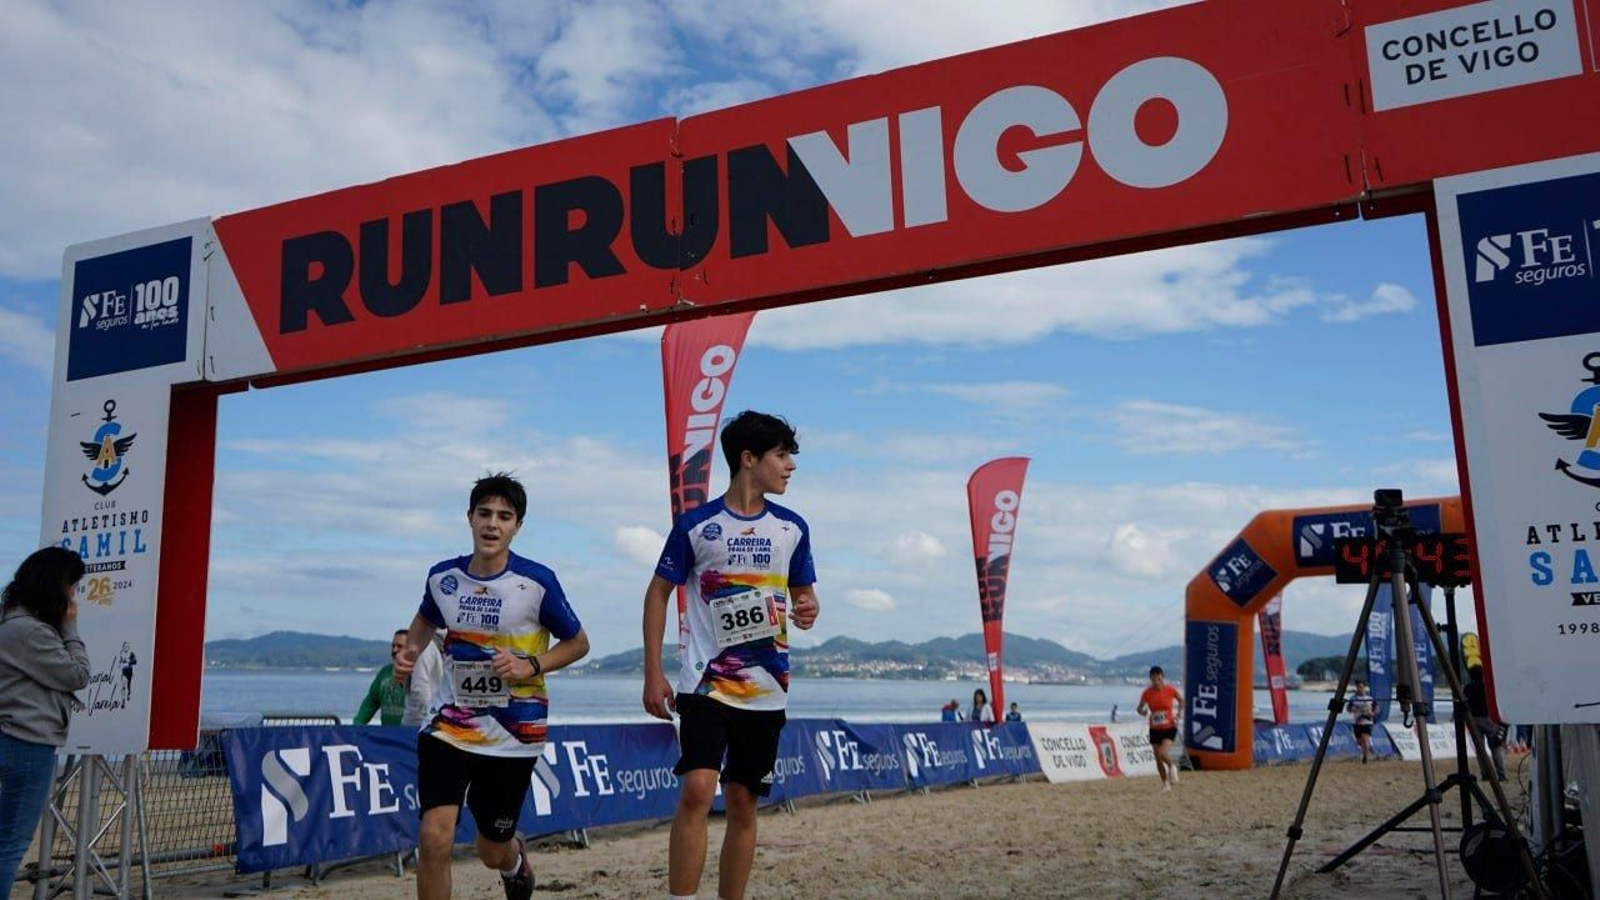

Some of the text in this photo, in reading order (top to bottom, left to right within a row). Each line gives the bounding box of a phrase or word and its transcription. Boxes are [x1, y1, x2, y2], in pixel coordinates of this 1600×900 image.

[1382, 9, 1557, 61] CONCELLO
[1405, 40, 1540, 86] DE VIGO
[1516, 228, 1576, 268] FE
[1514, 262, 1587, 286] seguros
[100, 290, 126, 318] FE
[135, 276, 180, 312] 100
[96, 316, 128, 332] seguros
[94, 500, 116, 511] CLUB
[61, 509, 149, 534] ATLETISMO
[727, 537, 772, 547] CARREIRA
[85, 562, 122, 573] ETERANOS
[752, 553, 771, 564] 100
[87, 576, 111, 601] 26
[112, 579, 133, 591] 2024
[460, 596, 502, 608] CARREIRA
[481, 613, 500, 626] 100
[720, 606, 764, 631] 386
[1558, 623, 1600, 635] 1998
[1205, 625, 1222, 683] seguros
[461, 676, 502, 693] 449
[1041, 737, 1087, 751] CONCELLO
[1120, 735, 1151, 748] CONCELL
[562, 740, 679, 800] FE seguros
[863, 753, 900, 776] seguos
[321, 745, 400, 819] FE
